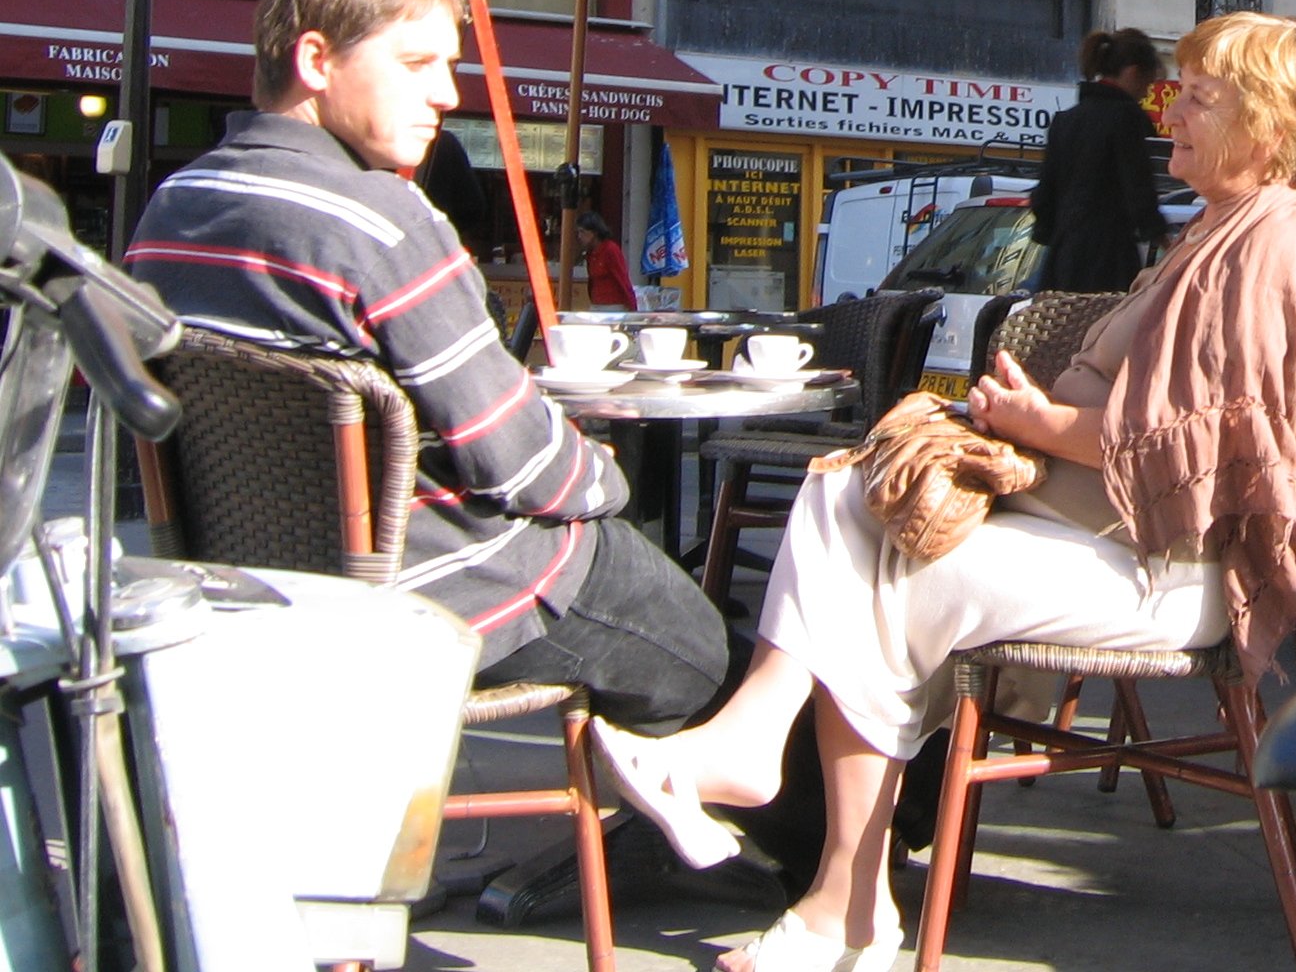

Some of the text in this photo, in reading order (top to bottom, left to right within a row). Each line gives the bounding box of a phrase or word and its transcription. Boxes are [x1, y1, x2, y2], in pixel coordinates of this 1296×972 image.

[66, 64, 123, 81] MAISO
[763, 64, 1034, 104] COPY TIME
[582, 89, 664, 108] SANDWICHS
[588, 106, 617, 120] HOT
[621, 108, 651, 122] DOG
[887, 96, 1051, 130] IMPRESSIO
[745, 113, 829, 131] Sorties
[837, 118, 923, 138] fichiers
[931, 126, 984, 142] MAC
[712, 154, 798, 173] PHOTOCOPIE
[745, 171, 763, 179] ICI
[708, 179, 801, 195] INTERNET
[727, 195, 758, 206] HAUT
[727, 217, 777, 227] SCANNER
[720, 236, 783, 246] IMPRESSION
[735, 248, 766, 258] LASER
